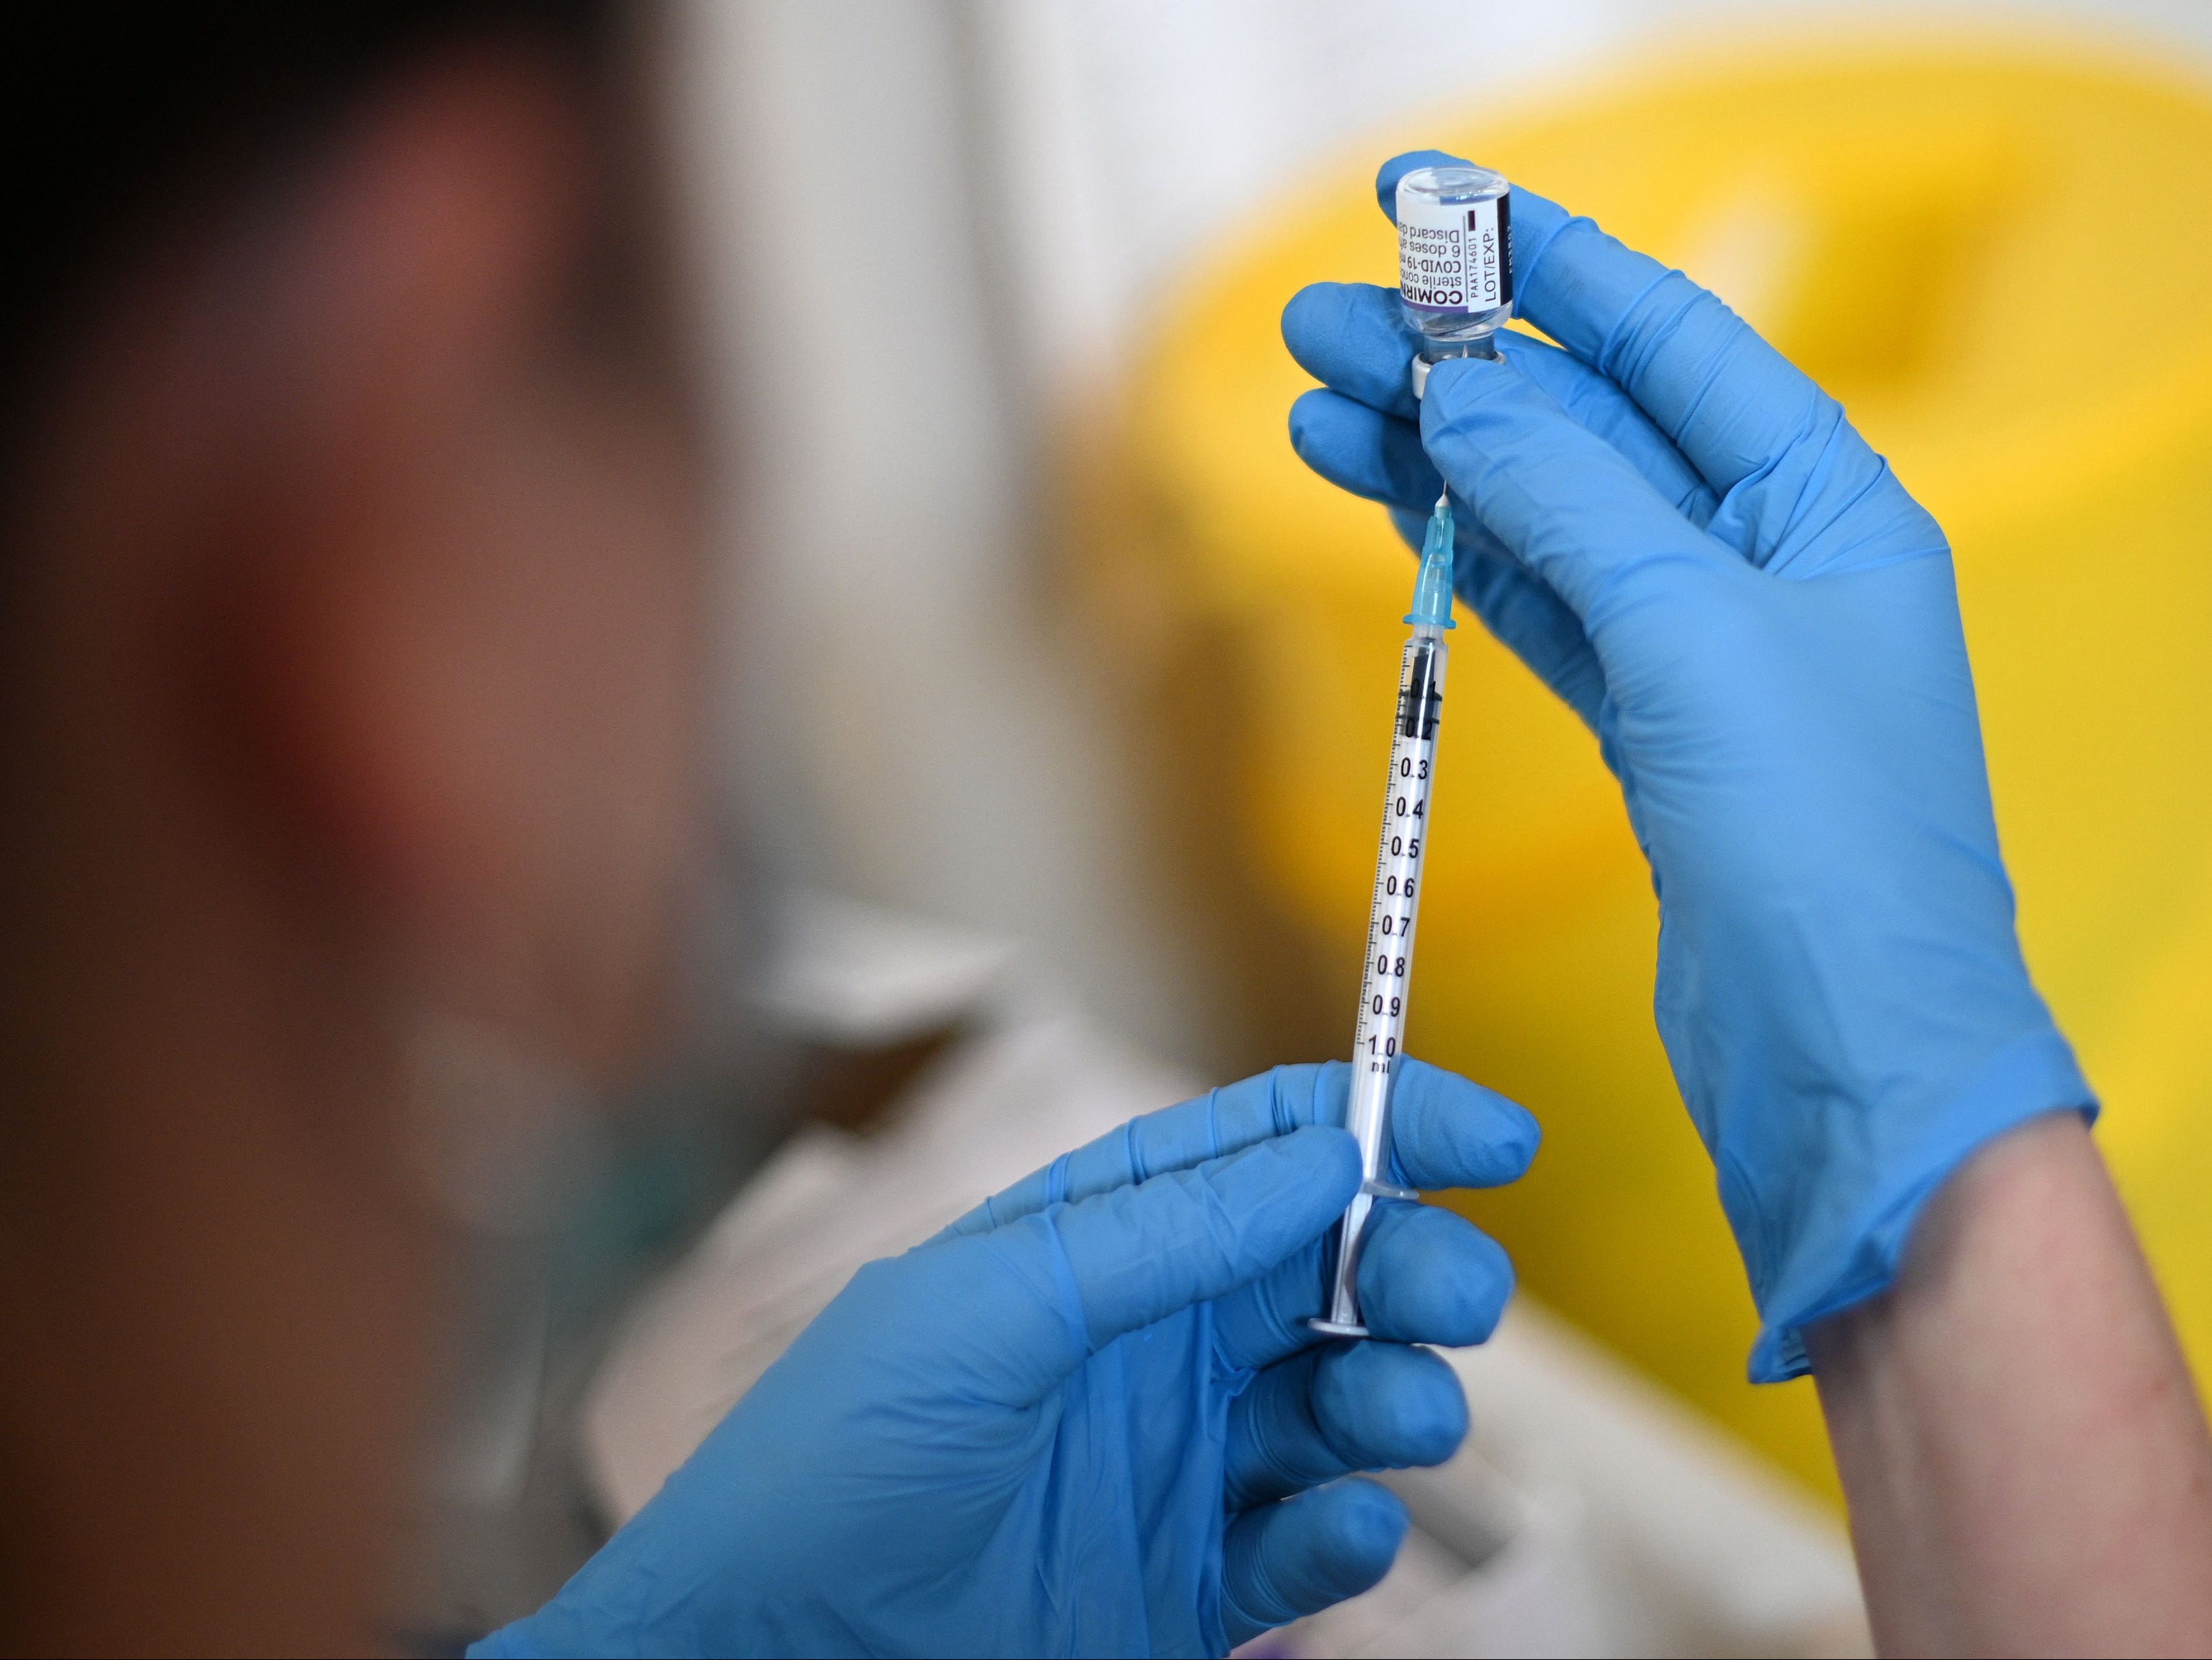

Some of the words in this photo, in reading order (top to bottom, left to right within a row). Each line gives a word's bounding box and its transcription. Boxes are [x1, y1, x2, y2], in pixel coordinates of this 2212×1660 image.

[1409, 227, 1460, 244] Discard
[1409, 241, 1447, 258] doses
[1451, 245, 1460, 258] 6
[1407, 256, 1461, 274] COVID-19
[1468, 237, 1478, 299] PAA174601
[1483, 227, 1496, 302] LOT/EXP:
[1421, 275, 1462, 289] sterile
[1411, 679, 1437, 699] 0.1
[1406, 720, 1433, 740] 0.2
[1400, 757, 1428, 780] 0.3
[1396, 796, 1424, 819] 0.4
[1391, 836, 1419, 858] 0.5
[1386, 875, 1415, 898] 0.6
[1382, 915, 1411, 937] 0.7
[1377, 954, 1405, 977] 0.8
[1372, 995, 1401, 1017] 0.9
[1368, 1034, 1396, 1057] 1.0
[1372, 1060, 1391, 1074] ml
